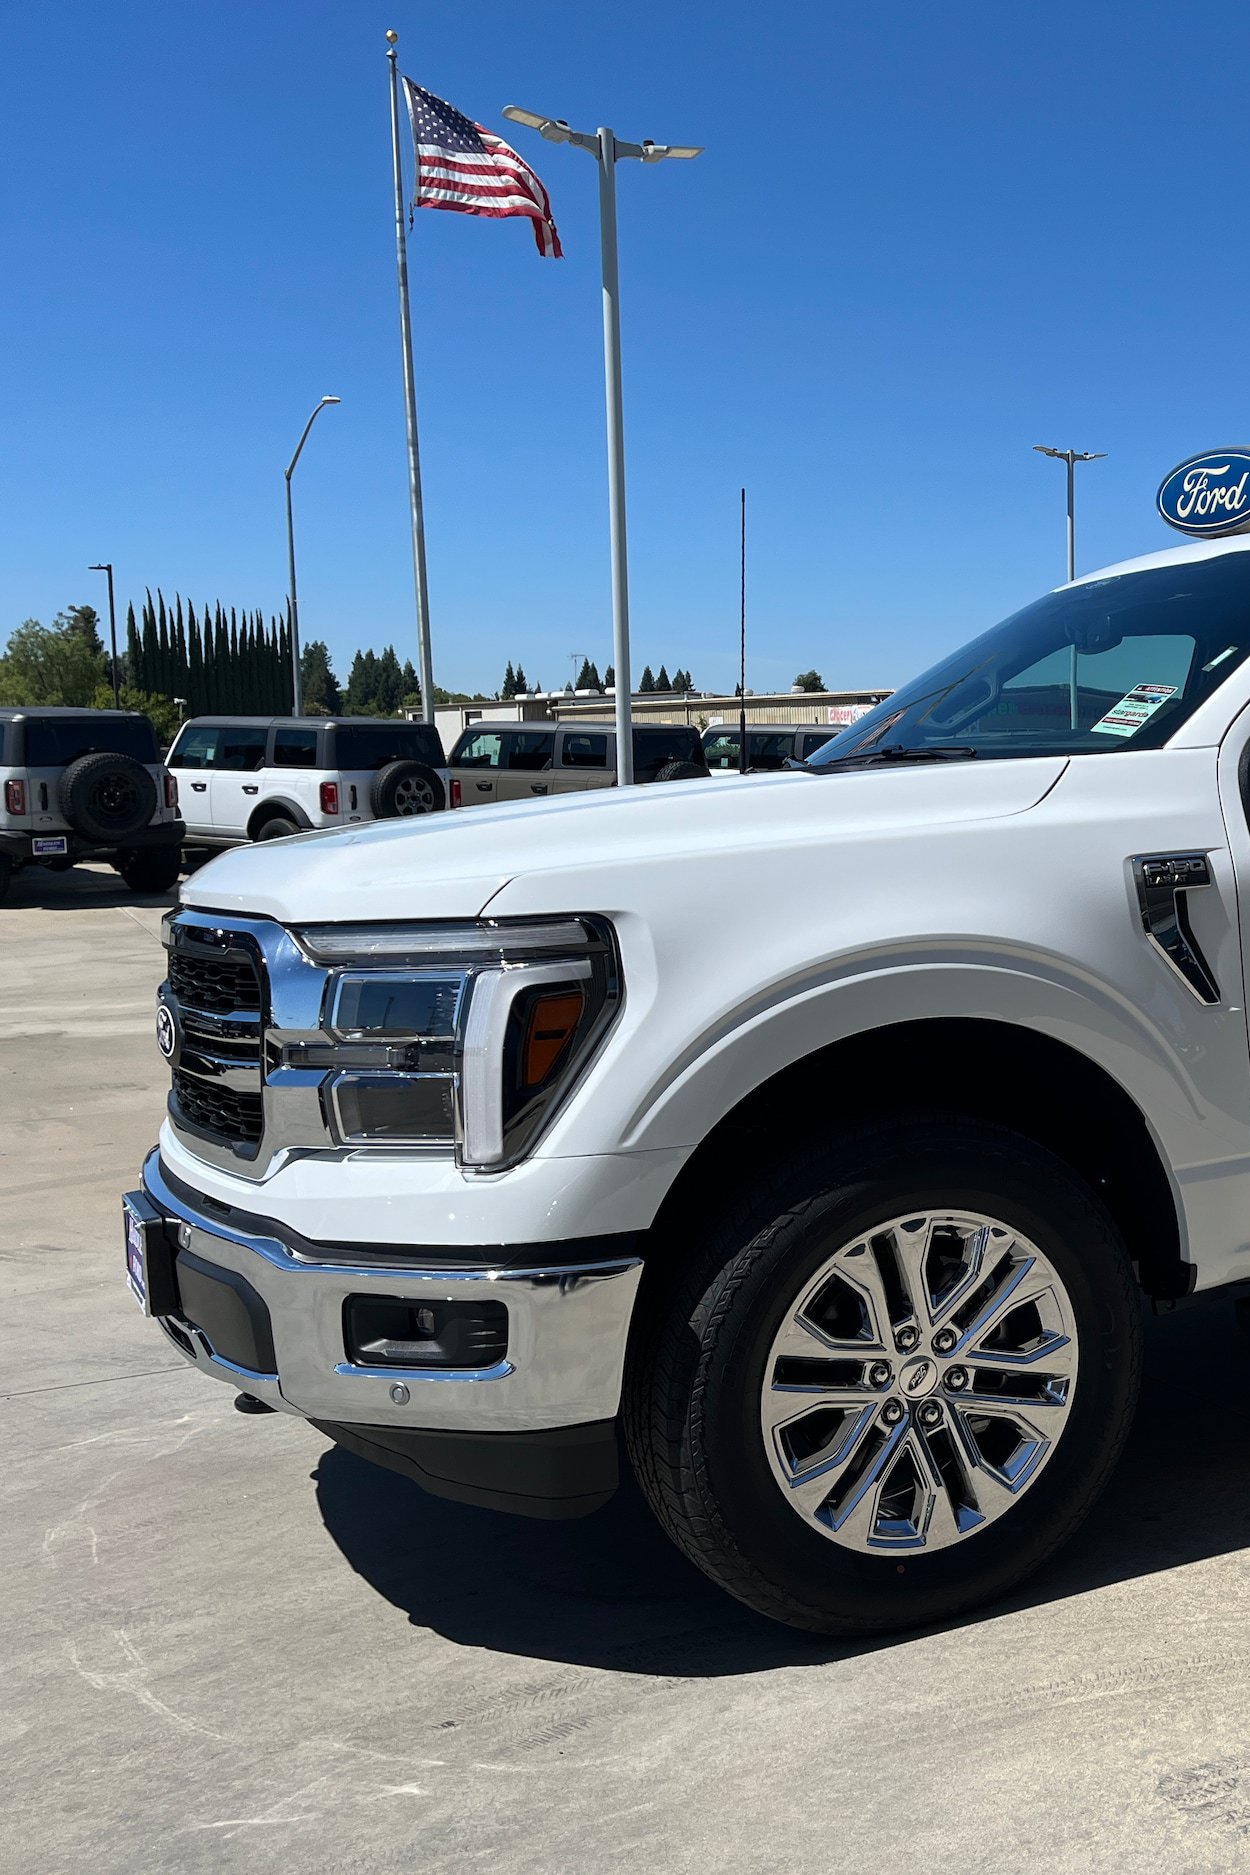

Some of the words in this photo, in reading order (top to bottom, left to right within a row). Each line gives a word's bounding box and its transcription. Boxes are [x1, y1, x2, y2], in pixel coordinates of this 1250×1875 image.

[1176, 465, 1250, 519] Ford
[1143, 858, 1206, 876] F-150
[911, 1365, 927, 1388] Ford
